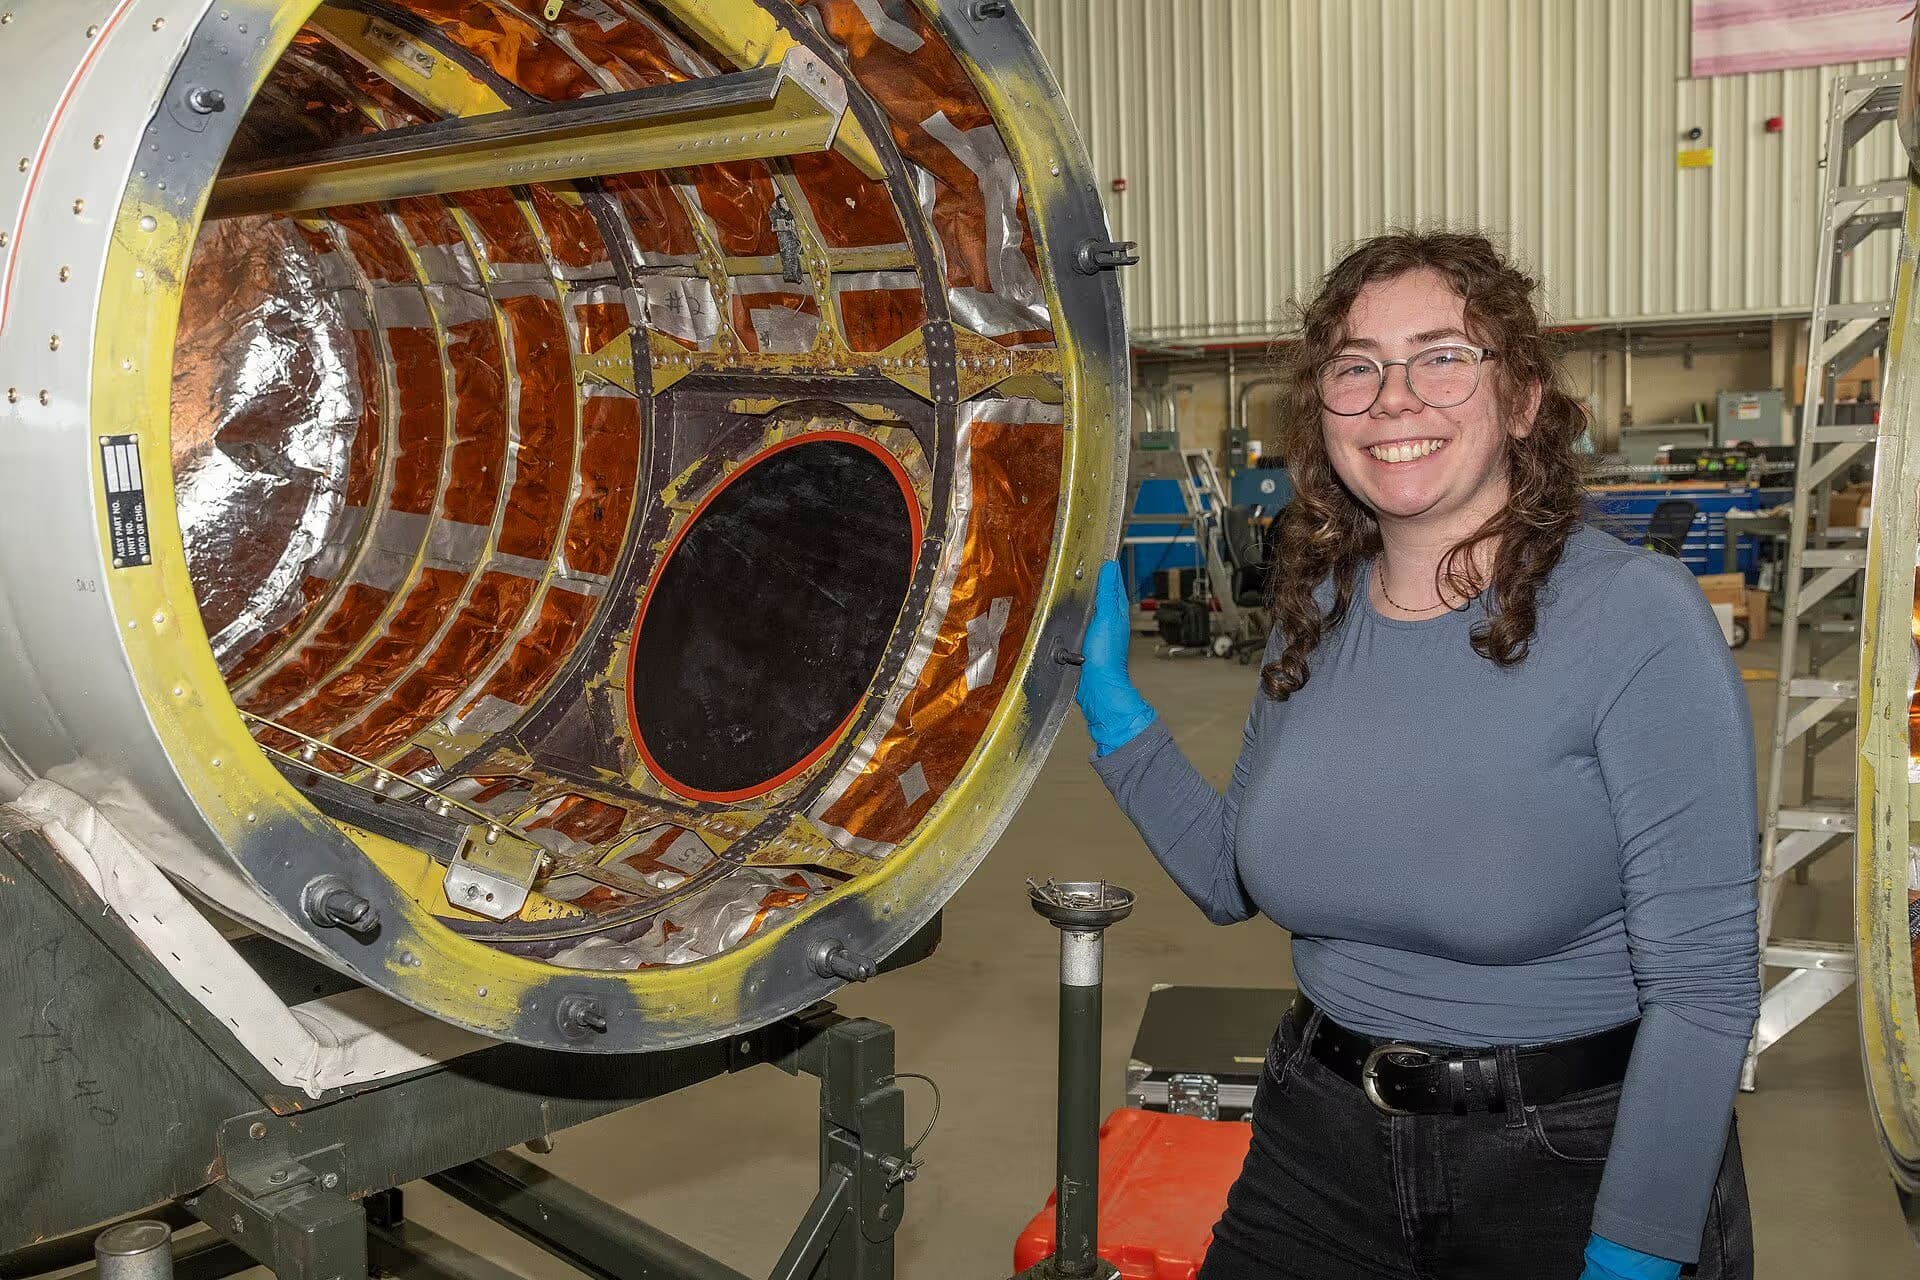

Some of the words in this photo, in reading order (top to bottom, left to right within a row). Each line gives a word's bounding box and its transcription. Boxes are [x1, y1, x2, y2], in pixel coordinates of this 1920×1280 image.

[112, 500, 120, 514] NO.
[134, 502, 144, 521] CHG.
[114, 516, 123, 536] PART
[125, 520, 133, 535] NO.
[137, 523, 145, 535] OR
[115, 538, 126, 557] ASSY
[127, 537, 137, 556] UNIT
[138, 536, 147, 555] MOD
